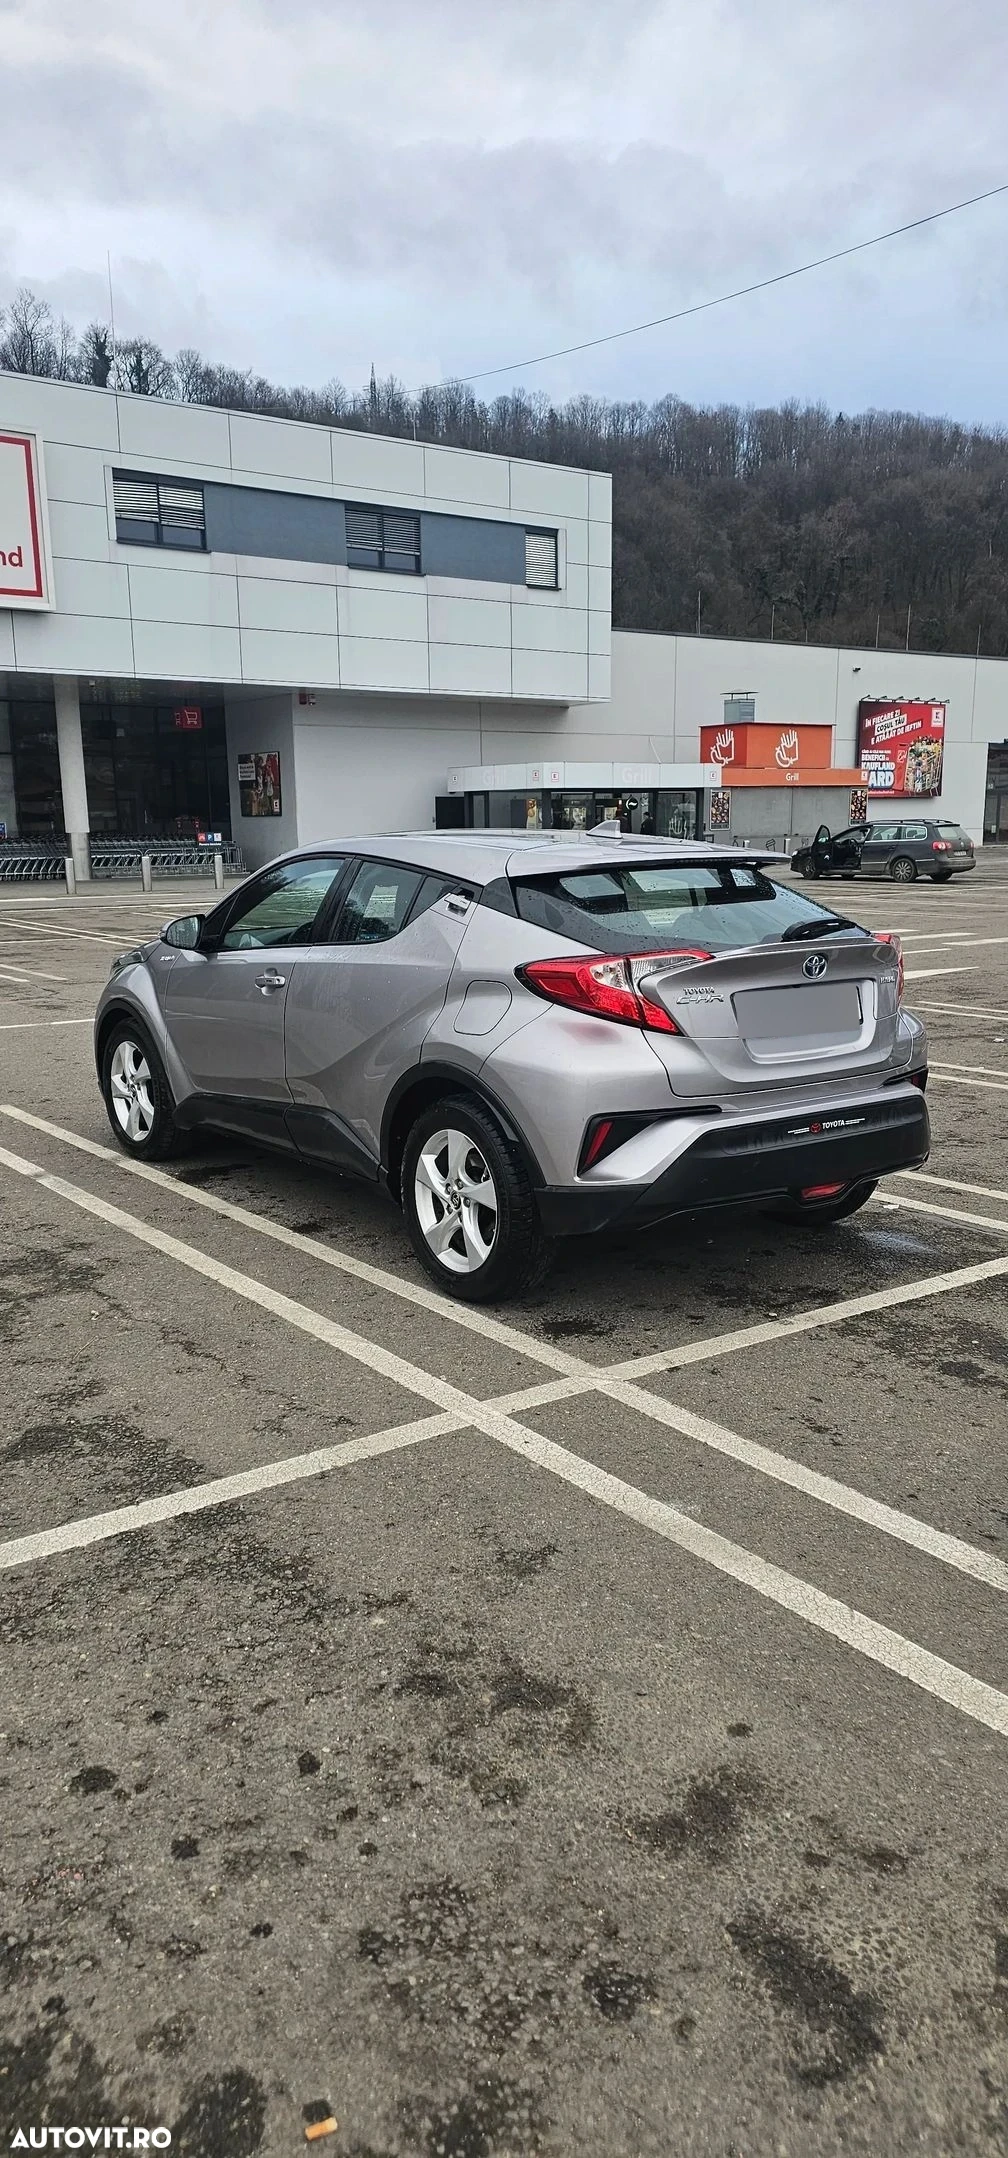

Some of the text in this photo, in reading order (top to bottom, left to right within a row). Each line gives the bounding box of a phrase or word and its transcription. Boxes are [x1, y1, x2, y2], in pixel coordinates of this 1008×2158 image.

[872, 712, 894, 725] FIECARE
[895, 709, 900, 717] ZI
[897, 727, 904, 735] DE
[905, 721, 922, 732] IEFTIN
[861, 762, 895, 770] KAUFLAND
[482, 768, 506, 787] Grill
[621, 766, 652, 785] Grill
[785, 772, 800, 782] Grill
[868, 771, 894, 787] ARD
[683, 986, 715, 996] TOYOTA
[676, 994, 724, 1004] C-HR
[822, 1119, 846, 1130] TOYOTA
